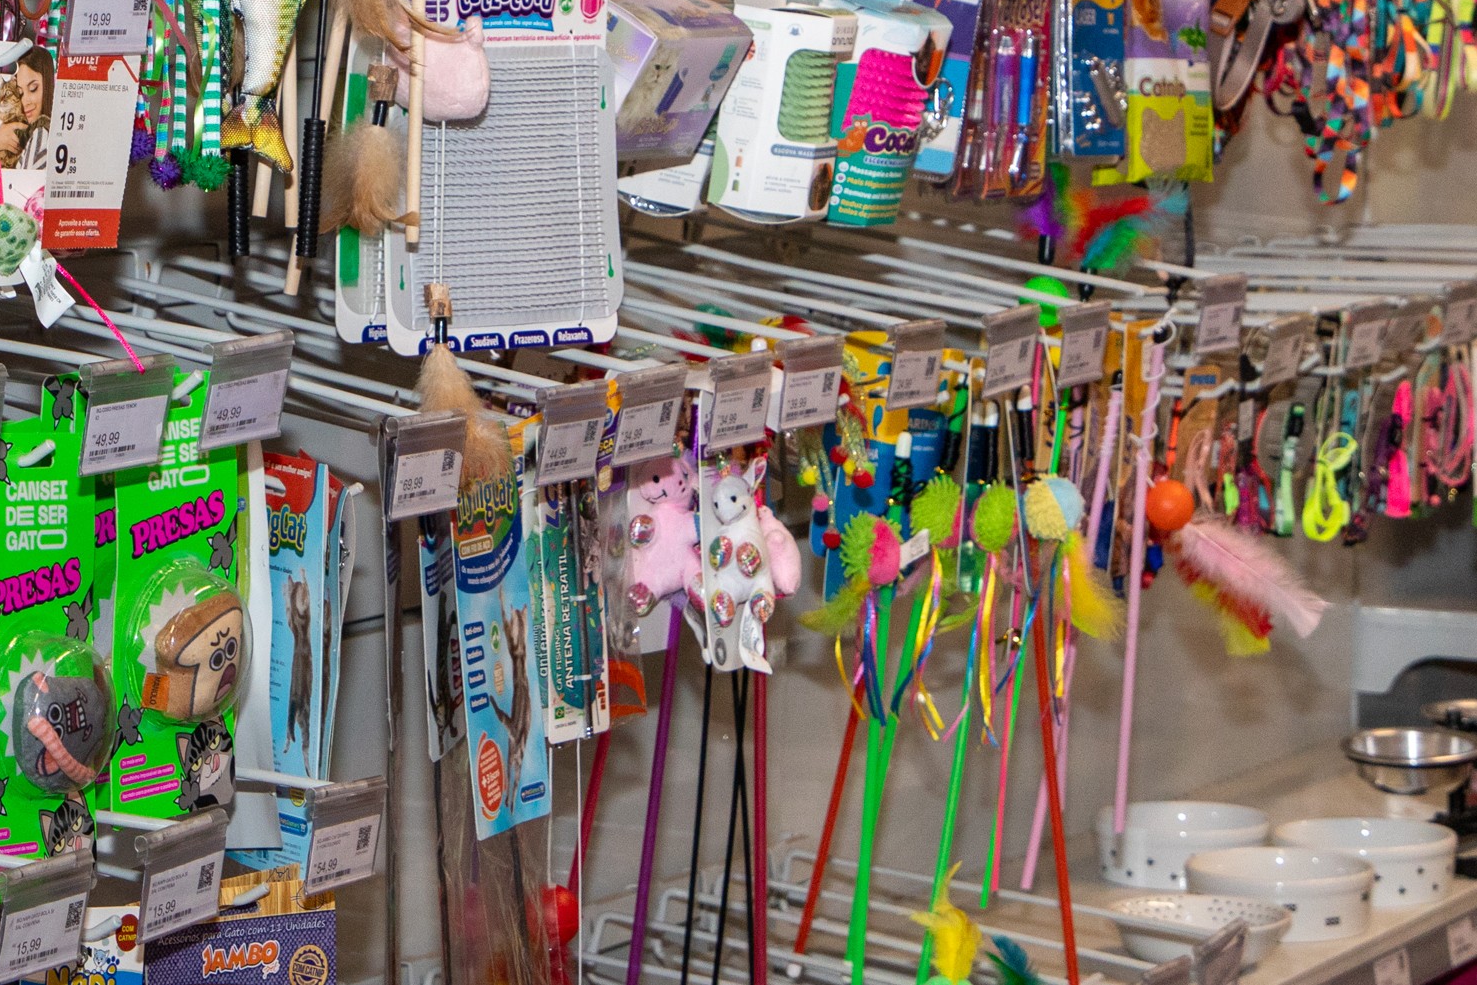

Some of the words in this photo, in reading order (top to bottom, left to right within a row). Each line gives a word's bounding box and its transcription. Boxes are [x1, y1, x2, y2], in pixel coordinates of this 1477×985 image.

[87, 12, 112, 27] 19,99
[486, 34, 512, 43] demarcam
[90, 83, 108, 92] PAWISE
[1139, 76, 1186, 101] Catnip
[60, 112, 74, 132] 19
[55, 144, 68, 174] 9
[58, 219, 77, 229] Aproveite
[82, 220, 98, 228] chance
[470, 335, 500, 349] Saudável
[514, 332, 546, 346] Prazeroso
[557, 329, 590, 343] Relaxante
[216, 405, 243, 422] 49,99
[95, 431, 120, 448] 49,99
[549, 447, 568, 460] 44,99
[147, 465, 211, 492] GATO
[402, 475, 424, 491] 69,99
[5, 479, 69, 503] CANSEI
[5, 504, 35, 527] DE
[45, 503, 69, 526] SER
[131, 488, 226, 559] PRESAS
[5, 529, 69, 551] GATO
[559, 549, 572, 625] RETRÁTIL
[555, 629, 563, 669] FISHING
[564, 636, 574, 690] ANTENA
[151, 676, 161, 705] MANOLO
[556, 672, 564, 692] CAT
[316, 858, 338, 875] 54,99
[152, 900, 177, 918] 15,99
[117, 933, 137, 942] CATNIP
[121, 925, 135, 933] COM
[201, 931, 224, 945] para
[224, 927, 246, 938] Gato
[247, 927, 268, 936] com
[270, 923, 283, 933] 11
[285, 918, 326, 931] Unidades
[15, 937, 42, 956] 15,99
[202, 939, 281, 979] JAMBO
[292, 962, 306, 973] COM
[305, 966, 325, 977] CATNIP
